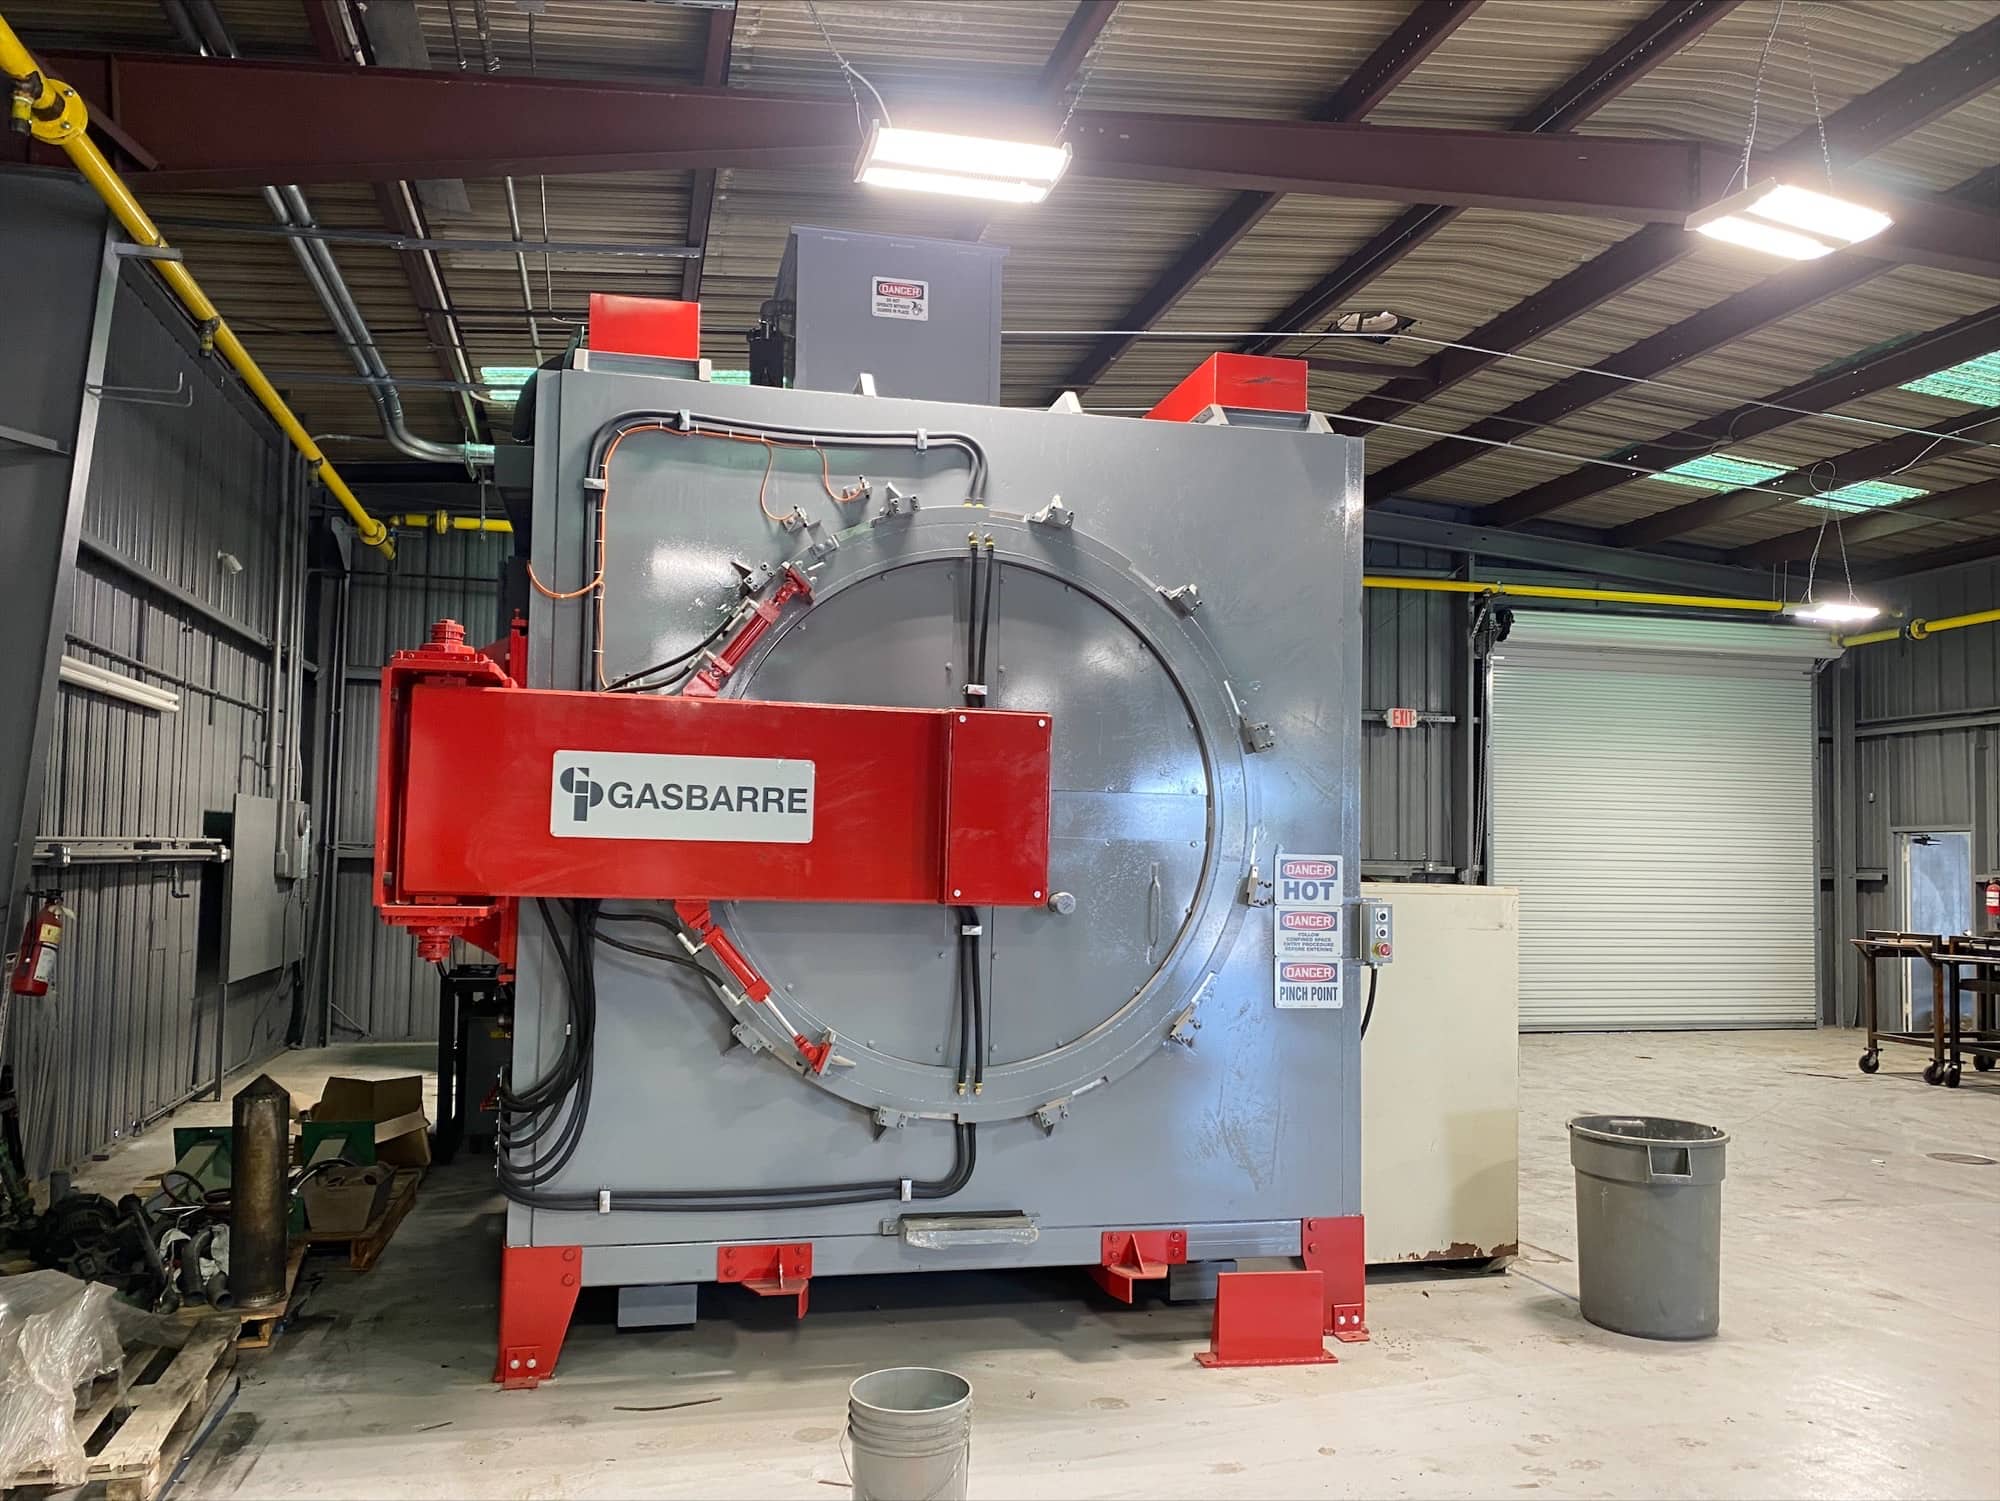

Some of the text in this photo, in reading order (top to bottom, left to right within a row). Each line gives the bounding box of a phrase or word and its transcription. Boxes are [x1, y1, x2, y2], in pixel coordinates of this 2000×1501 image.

[881, 285, 920, 296] DANGER
[1393, 710, 1413, 726] EXIT
[608, 782, 808, 813] GASBARRE
[1287, 864, 1332, 875] DANGER
[1284, 881, 1334, 900] HOT
[1286, 915, 1332, 927] DANGER
[1287, 967, 1332, 978] DANGER
[1280, 986, 1338, 1001] PINCH POINT
